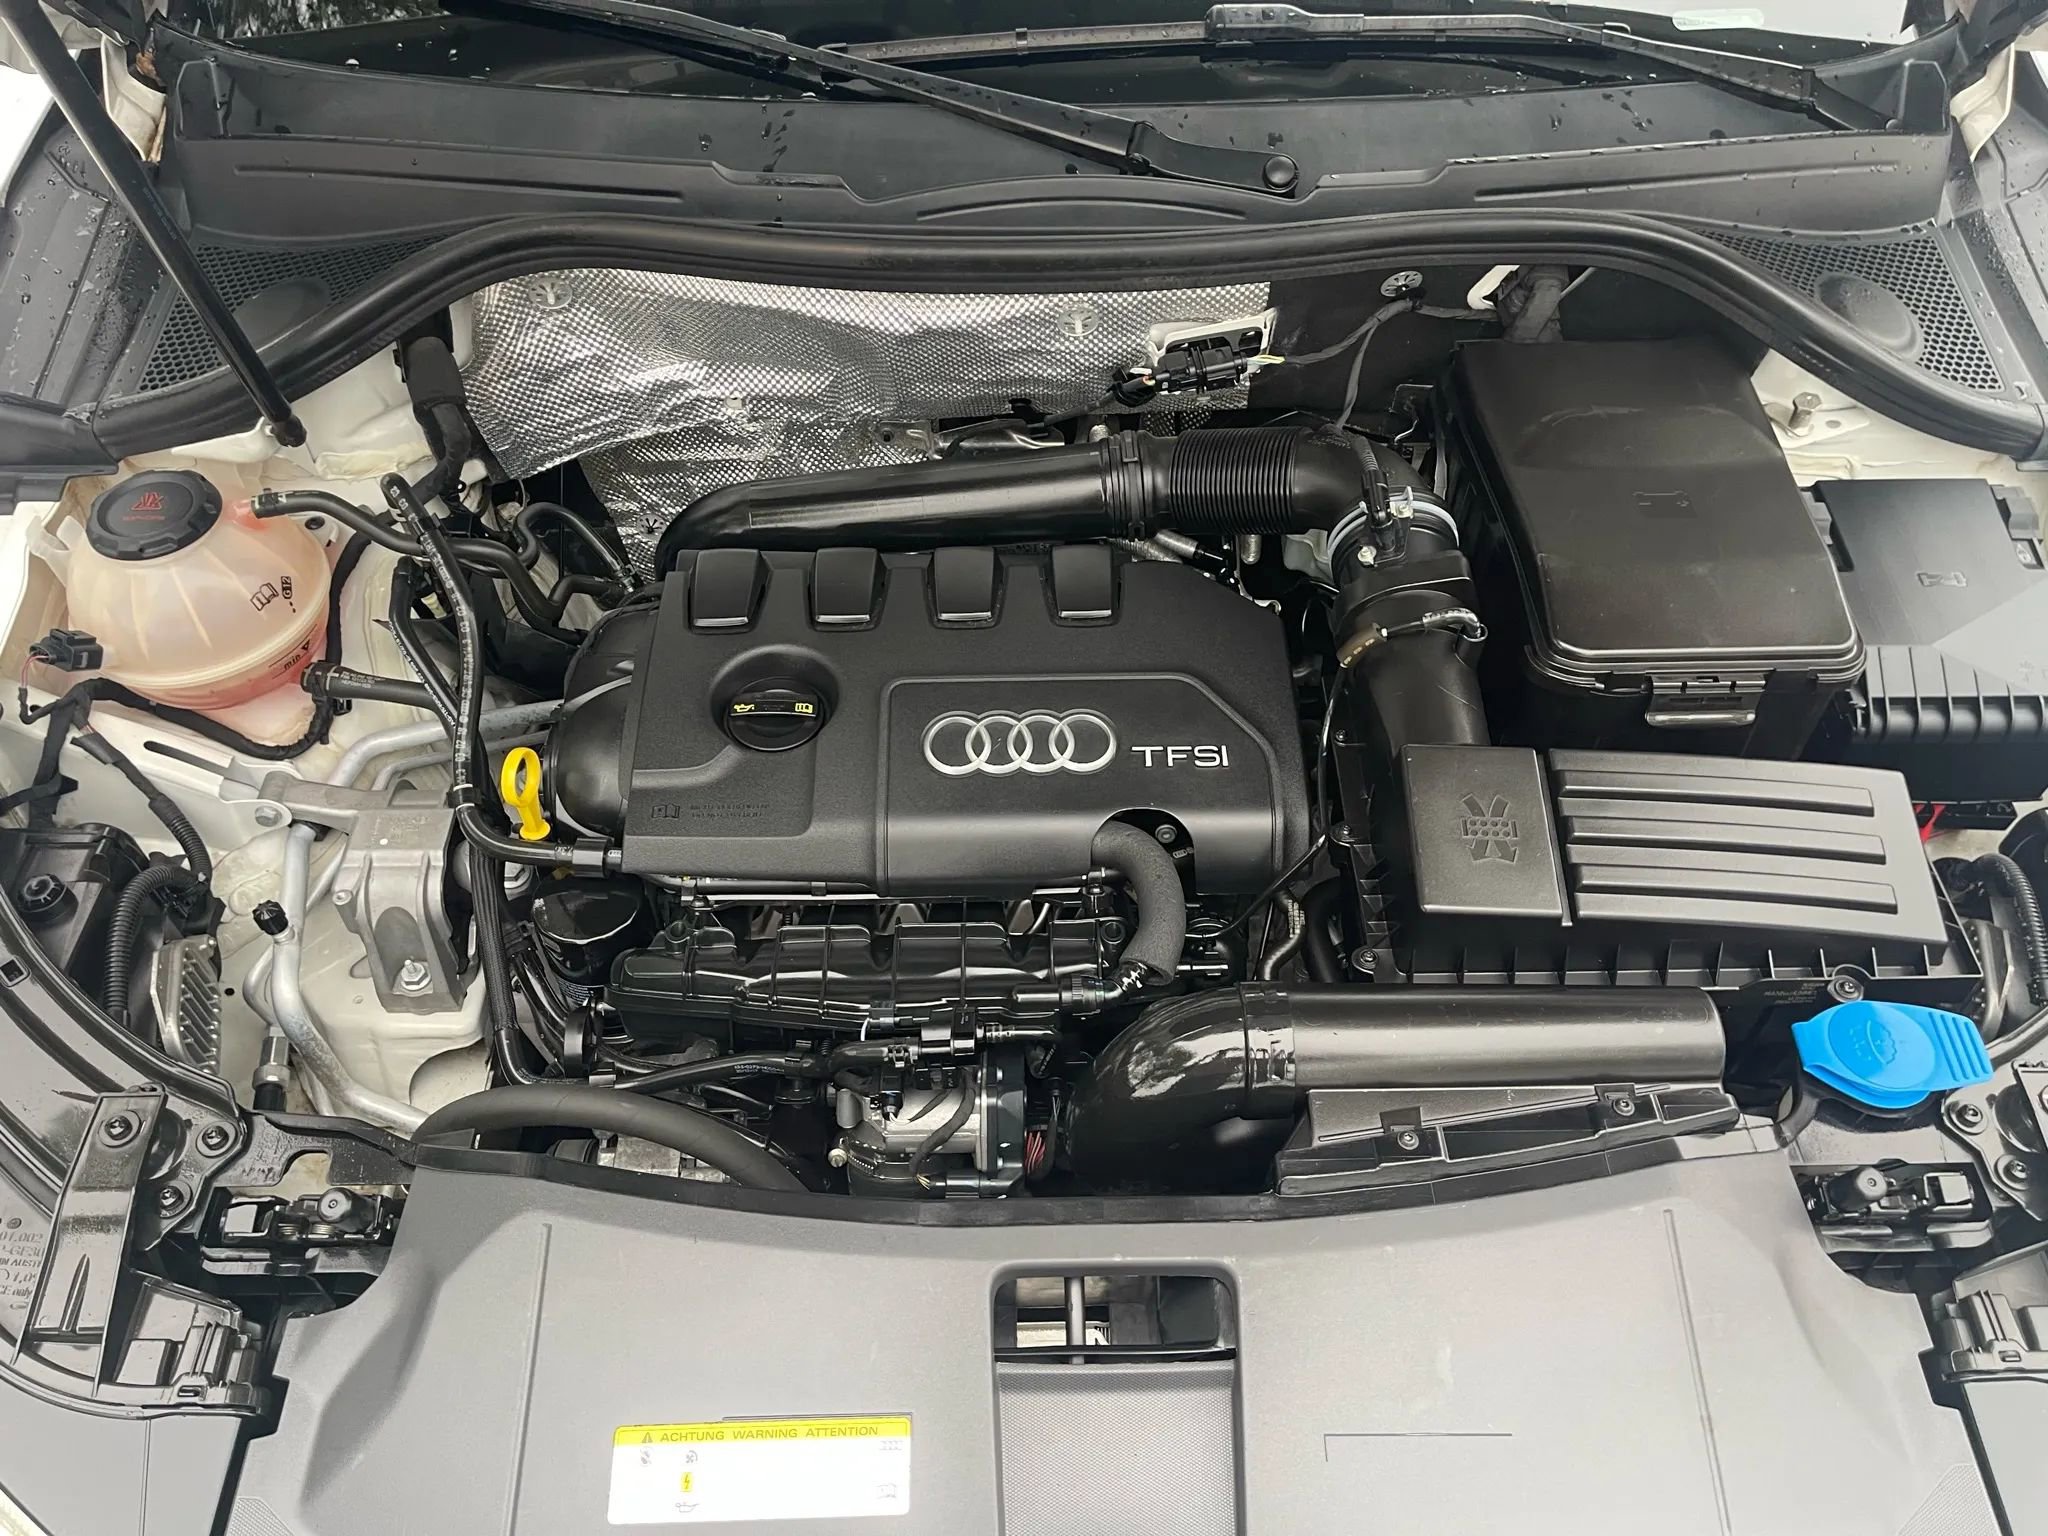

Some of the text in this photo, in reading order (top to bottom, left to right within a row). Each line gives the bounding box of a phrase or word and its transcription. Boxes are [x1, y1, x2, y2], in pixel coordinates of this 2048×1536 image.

[284, 654, 301, 669] min
[1131, 745, 1229, 767] TFSI
[660, 1425, 878, 1443] ACHTUNG WARNING ATTENTION
